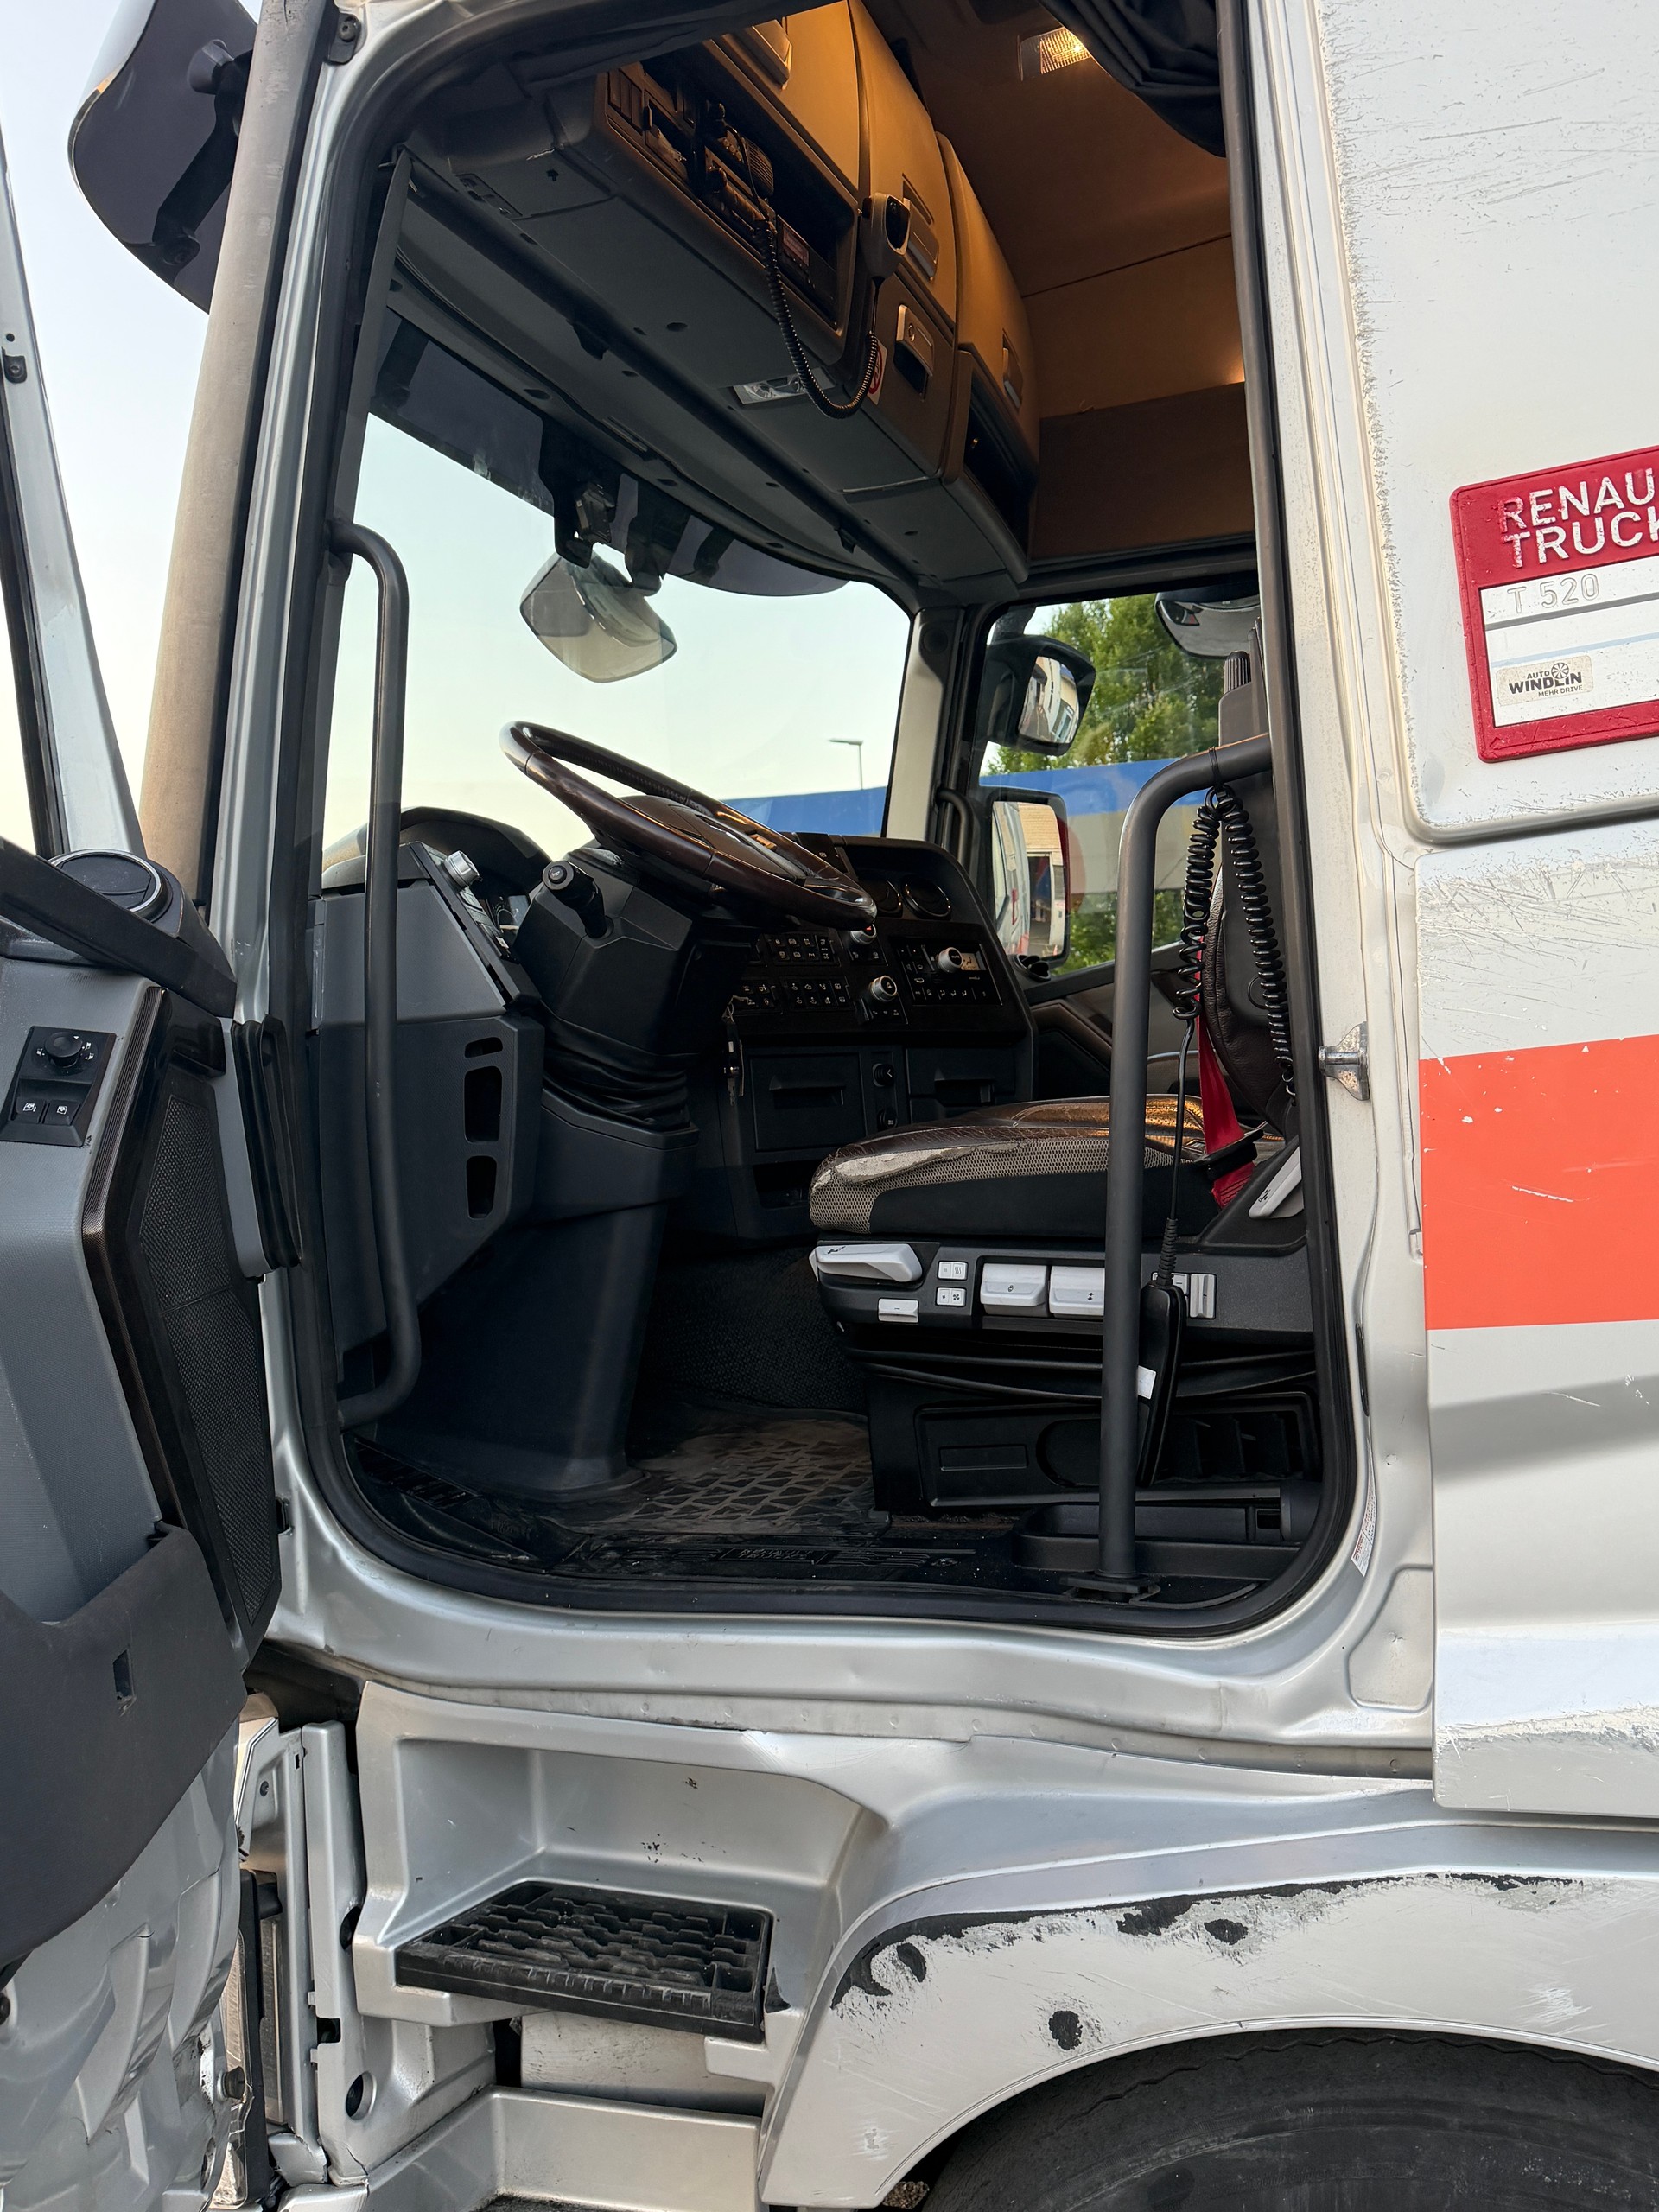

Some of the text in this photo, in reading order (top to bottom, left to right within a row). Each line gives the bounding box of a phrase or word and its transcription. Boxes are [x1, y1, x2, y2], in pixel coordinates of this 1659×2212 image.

[1497, 467, 1656, 533] RENAU
[1507, 573, 1599, 613] T 520
[1509, 671, 1582, 694] WINDLIN
[1527, 670, 1550, 679] AUTO
[1538, 685, 1583, 697] MEHR DRIVE
